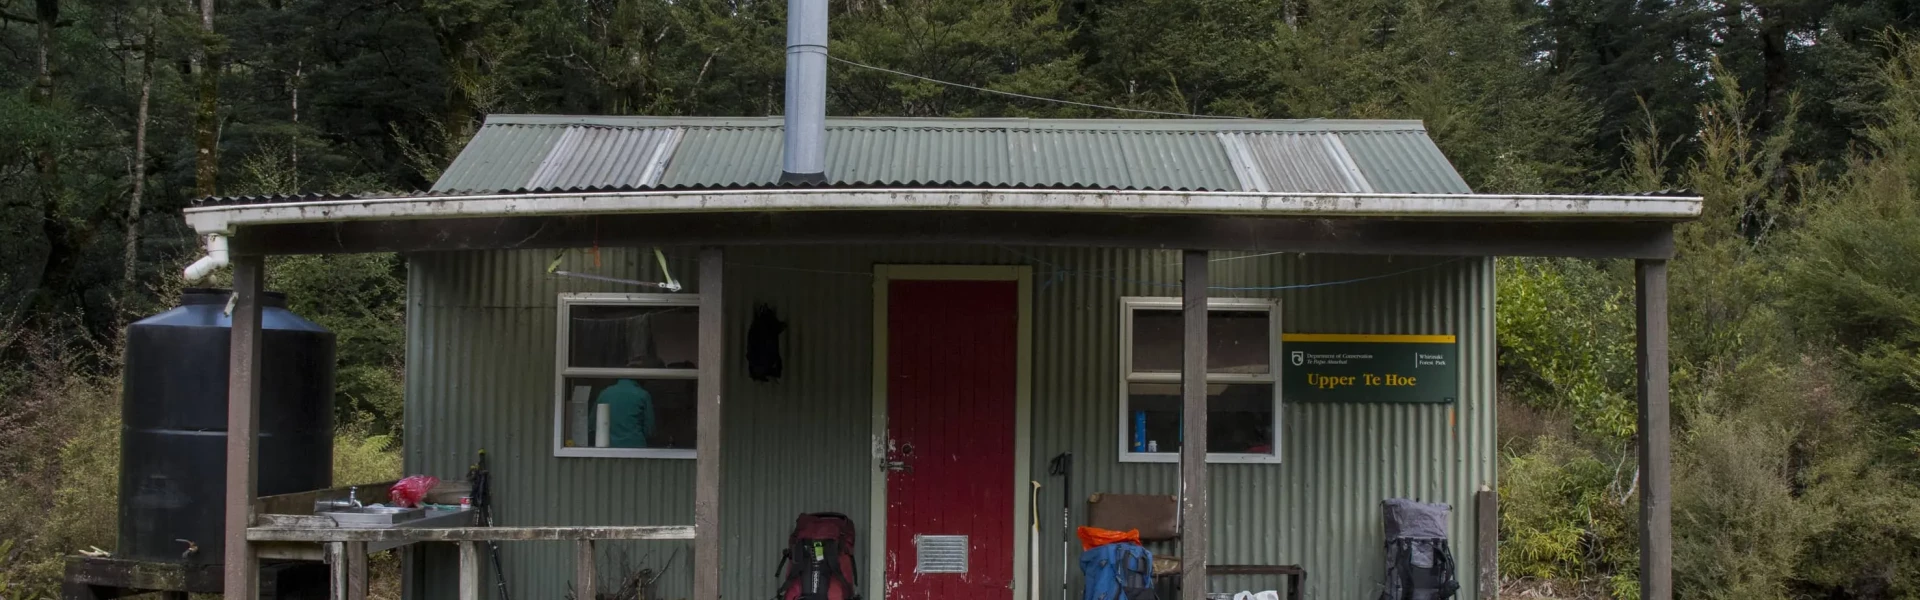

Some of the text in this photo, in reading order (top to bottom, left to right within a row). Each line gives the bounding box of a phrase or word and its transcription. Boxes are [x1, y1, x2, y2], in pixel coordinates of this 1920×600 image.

[1307, 373, 1417, 389] Upper Te Hoe
